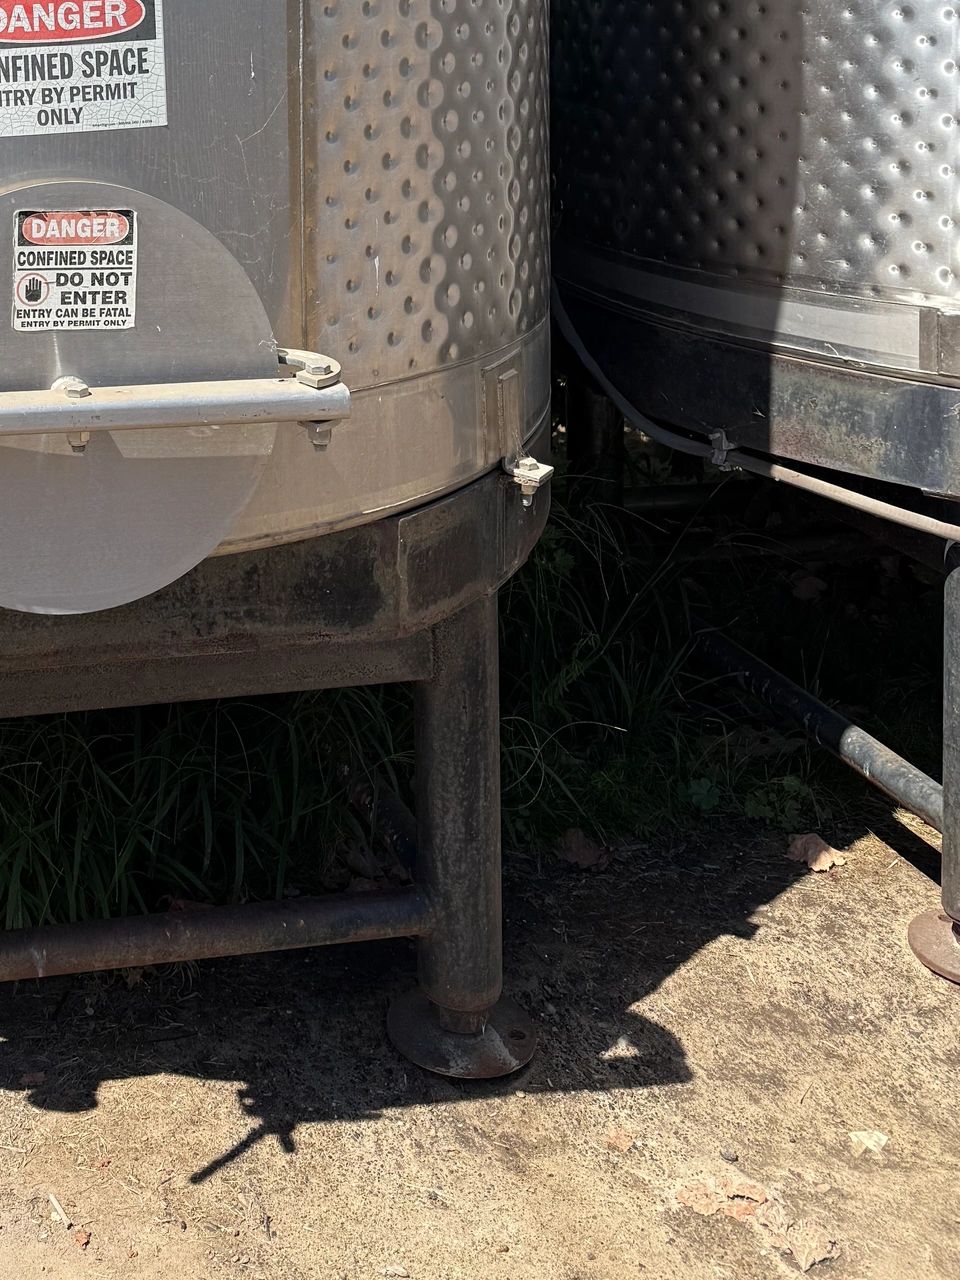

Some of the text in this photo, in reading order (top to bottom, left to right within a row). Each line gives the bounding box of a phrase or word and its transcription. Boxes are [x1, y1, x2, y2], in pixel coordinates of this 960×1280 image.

[81, 47, 150, 79] SPACE
[41, 86, 65, 105] BY
[70, 82, 138, 103] PERMIT
[37, 107, 84, 127] ONLY
[31, 218, 120, 238] DANGER
[17, 250, 134, 267] CONFINED SPACE
[55, 272, 133, 287] DO NOT
[60, 290, 127, 306] ENTER
[16, 307, 132, 319] ENTRY CAN BE FATAL
[20, 320, 49, 328] ENTRY
[53, 320, 64, 328] BY
[103, 319, 127, 327] ONLY
